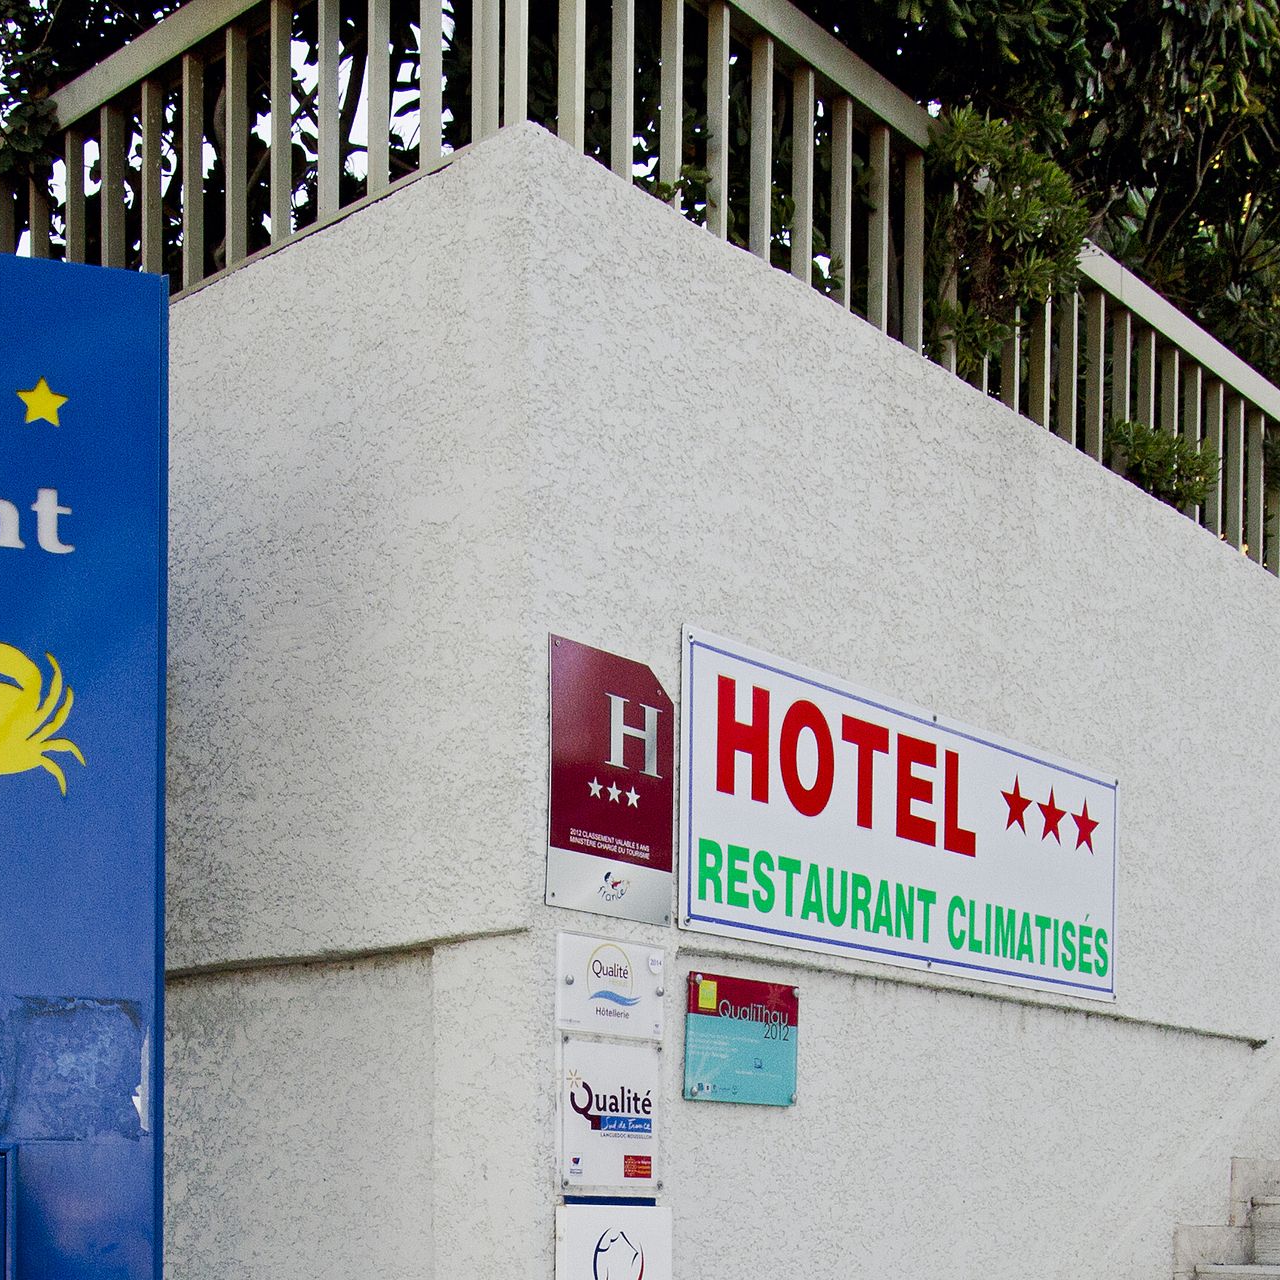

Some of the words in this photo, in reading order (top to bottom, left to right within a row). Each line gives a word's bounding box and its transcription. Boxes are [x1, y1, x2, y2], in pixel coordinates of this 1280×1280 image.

[604, 692, 664, 780] H
[716, 674, 977, 858] HOTEL
[582, 831, 614, 844] CLASSEMENT
[626, 849, 650, 859] TOURISME
[698, 838, 937, 944] RESTAURANT
[947, 895, 1109, 978] CLIMATISÉS
[592, 959, 629, 979] Qualité
[595, 1006, 630, 1019] Hôtellerie
[718, 999, 789, 1026] QualiThau
[763, 1023, 790, 1041] 2012
[570, 1081, 652, 1120] Qualité
[602, 1117, 617, 1130] Sud
[618, 1120, 627, 1129] de
[627, 1118, 651, 1130] France
